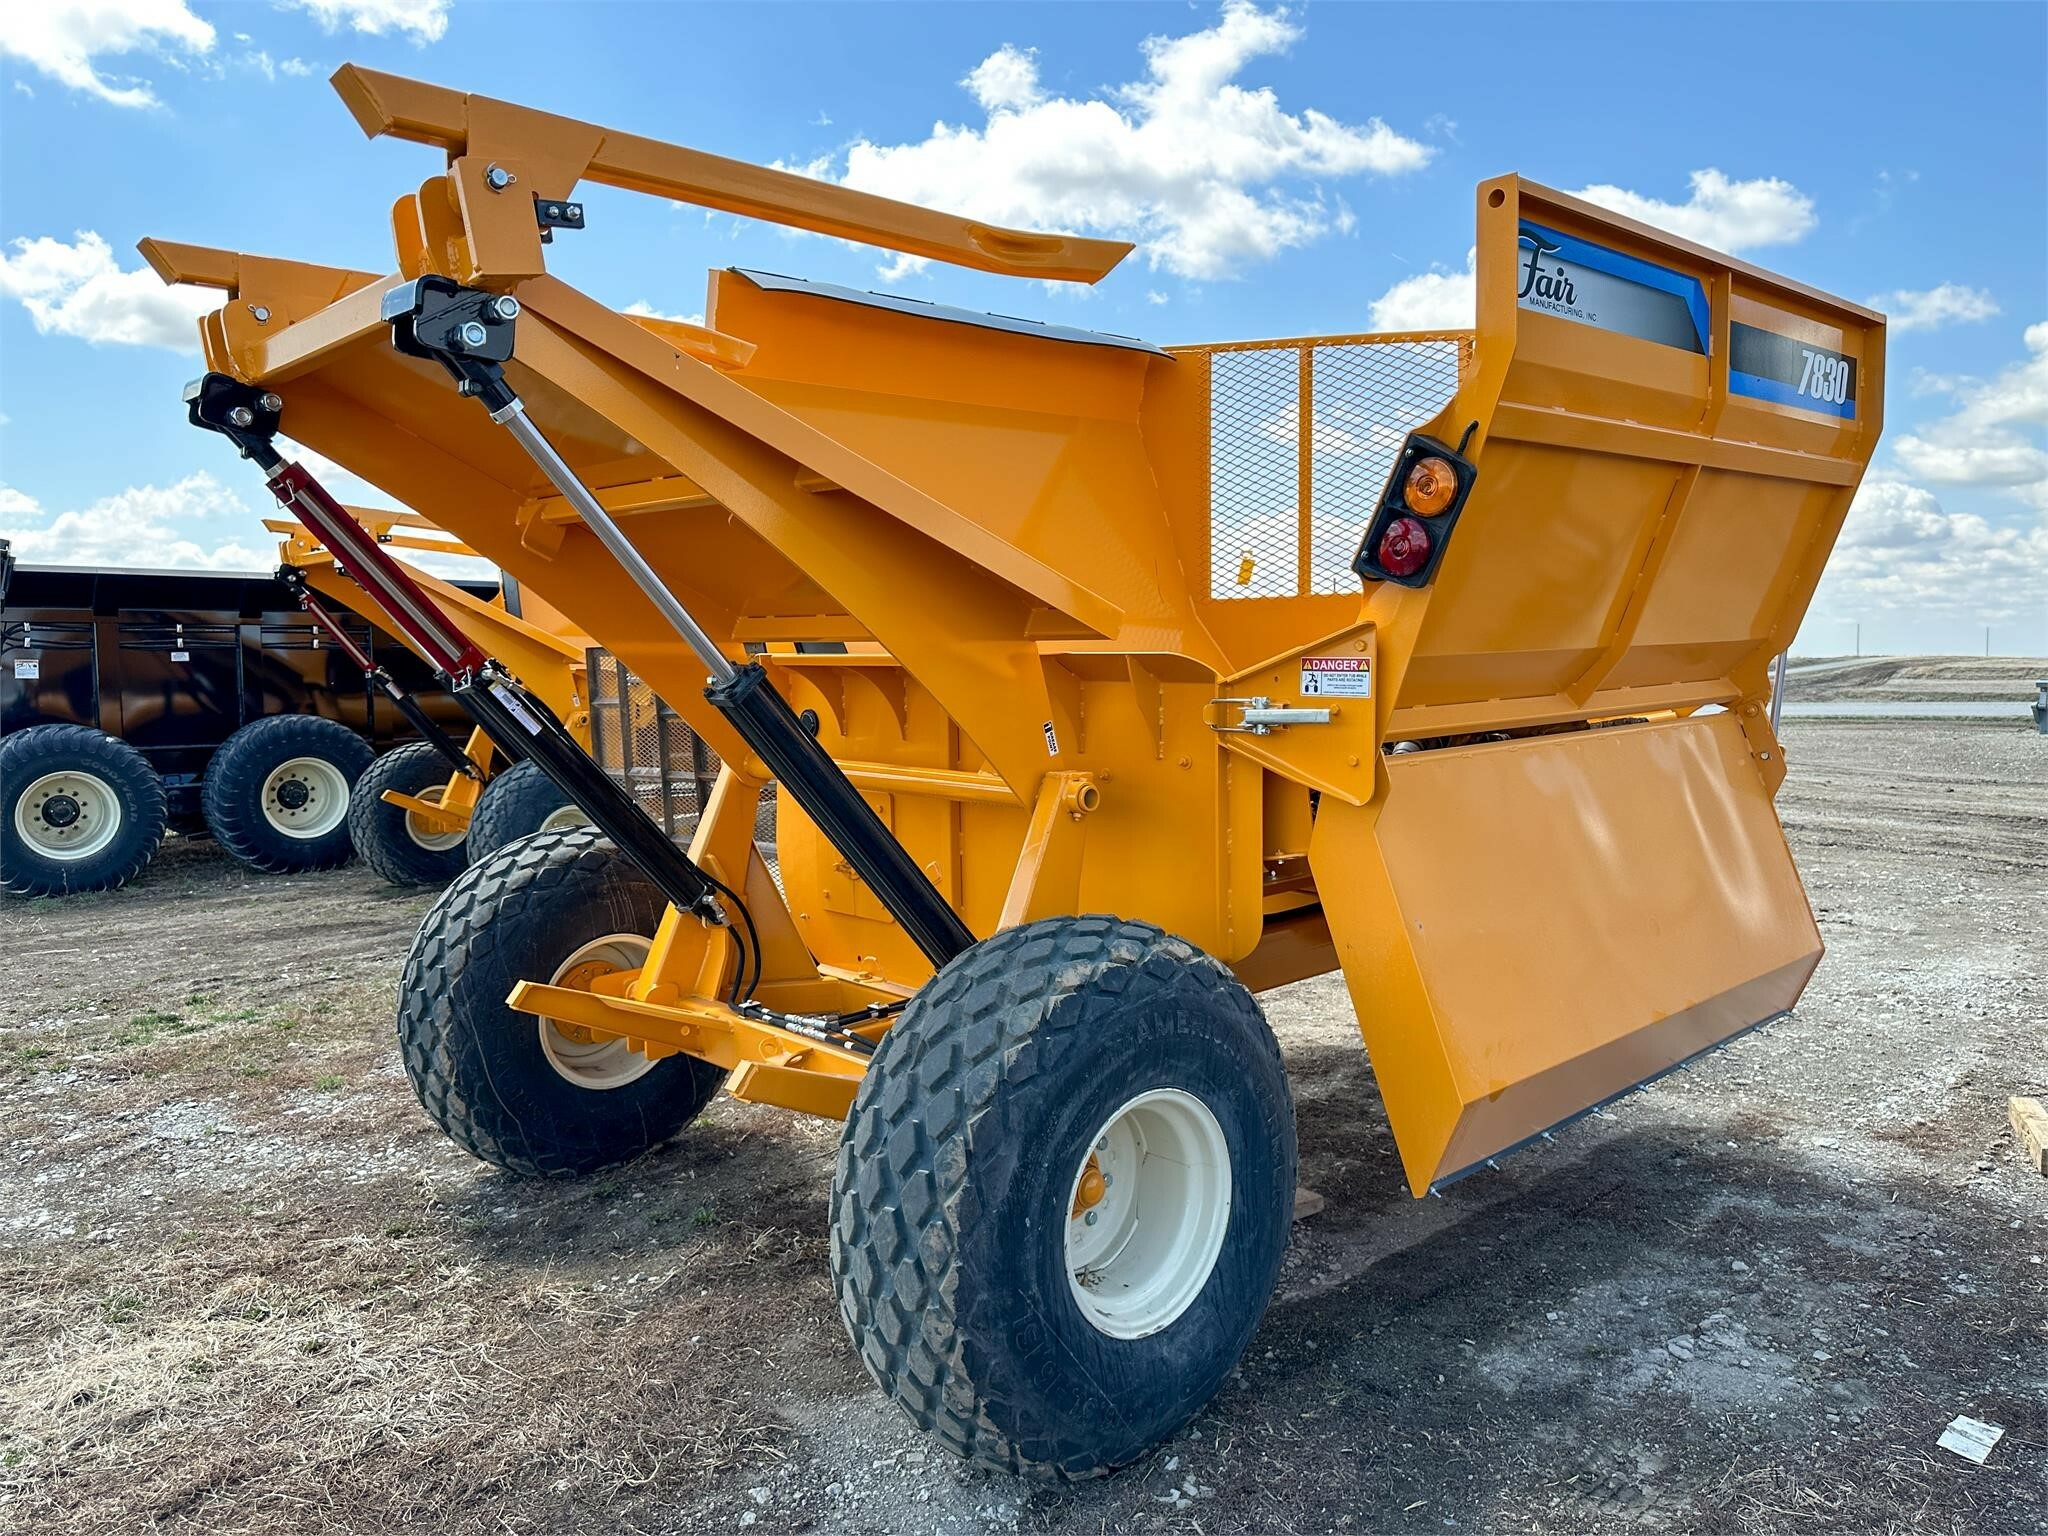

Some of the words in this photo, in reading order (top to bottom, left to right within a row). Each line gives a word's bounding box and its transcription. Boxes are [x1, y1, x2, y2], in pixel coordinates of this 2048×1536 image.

[1518, 228, 1579, 306] Fair
[1797, 349, 1849, 405] 7830
[1312, 660, 1358, 670] DANGER
